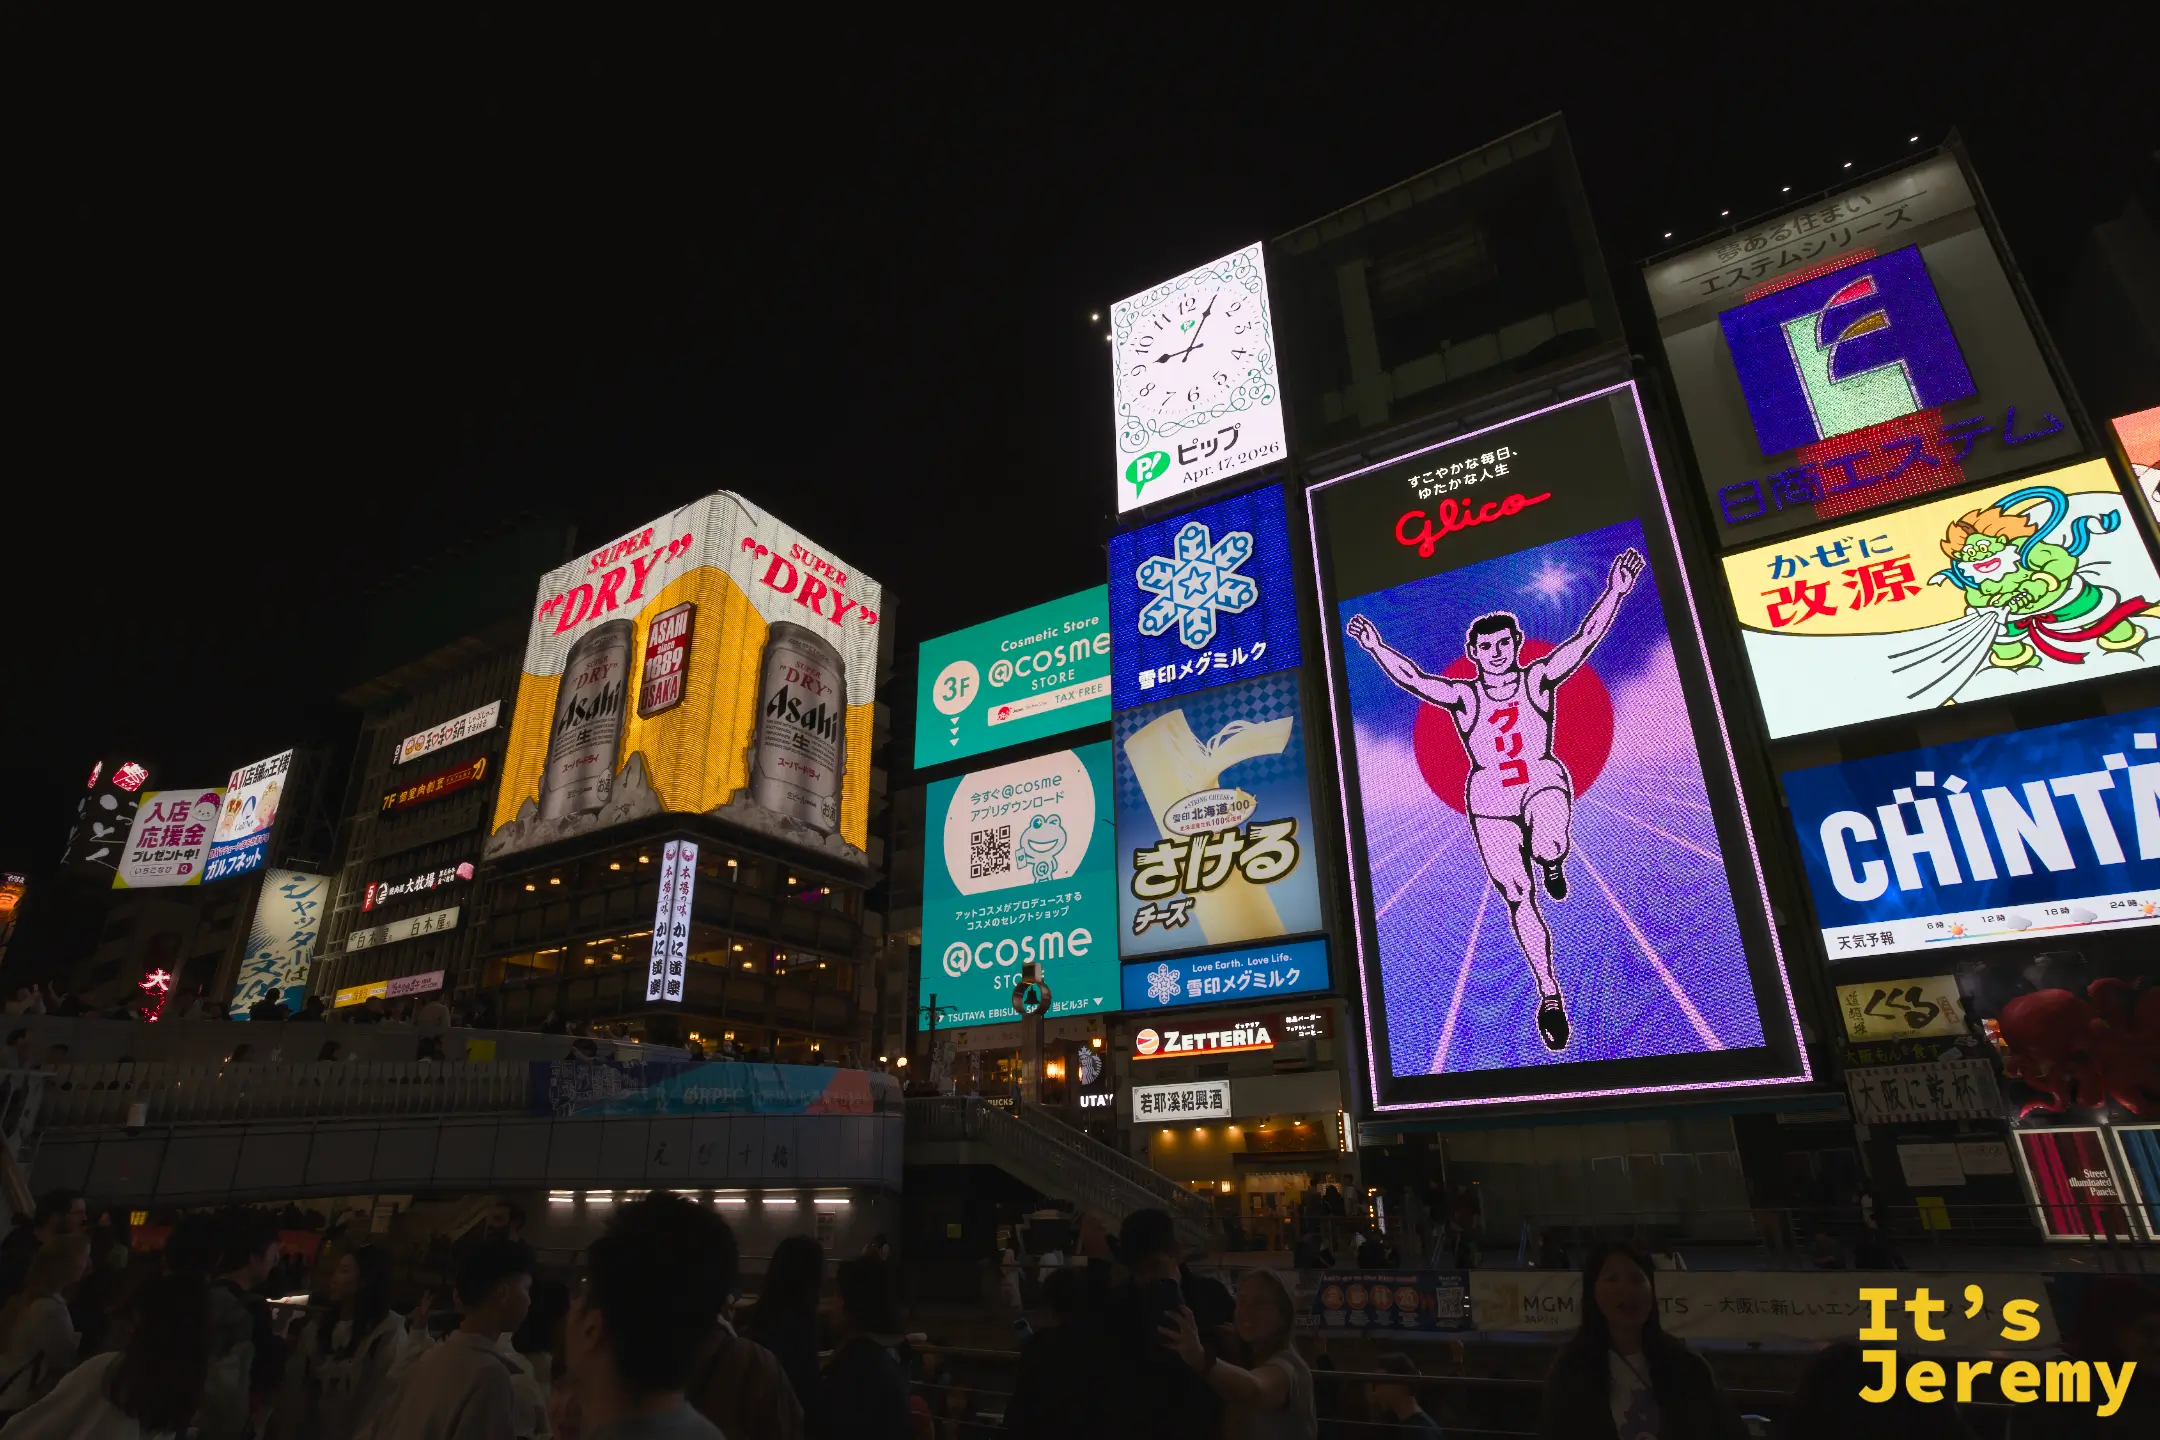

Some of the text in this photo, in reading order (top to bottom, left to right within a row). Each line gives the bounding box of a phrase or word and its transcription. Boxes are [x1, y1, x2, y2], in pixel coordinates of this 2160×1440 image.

[1714, 192, 1873, 265] 夢ある住まい
[1701, 203, 1912, 296] エステムシリーズ
[1178, 297, 1197, 315] 12
[1154, 314, 1171, 331] 11
[1234, 323, 1252, 335] 3
[1135, 335, 1154, 356] 10
[1230, 348, 1247, 361] 4
[1131, 364, 1147, 377] 9
[1212, 370, 1228, 386] 5
[1139, 382, 1156, 398] 8
[1161, 391, 1176, 407] 7
[1187, 386, 1200, 403] 6
[1178, 422, 1242, 466] ピップ
[1183, 441, 1280, 484] Apr. 17, 2026
[1407, 446, 1518, 489] すこやかな毎日、
[1717, 404, 2066, 523] 日商エステム
[1418, 463, 1510, 500] ゆたかな人生
[587, 527, 655, 575] SUPER
[1766, 533, 1895, 580] かぜに
[788, 543, 849, 588] SUPER
[1760, 553, 1923, 629] 改源
[648, 611, 688, 648] ASAHI
[1001, 614, 1099, 653] Cosmetic Store
[656, 641, 676, 655] since
[986, 631, 1110, 688] @cosme
[643, 646, 684, 682] 1889
[795, 660, 821, 677] SUPER
[1138, 640, 1267, 691] 雪印メグミルク
[941, 673, 971, 703] 3F
[1031, 668, 1076, 692] STORE
[640, 675, 681, 712] OSAKA
[1055, 683, 1103, 704] TAX FREE
[557, 680, 622, 736] Asahi
[766, 684, 838, 744] Asahi
[577, 729, 592, 746] 生
[792, 733, 811, 751] 生
[1487, 700, 1530, 788] グリコ
[229, 752, 292, 793] AI店舗の王様
[562, 753, 600, 775] スーパードライ
[777, 757, 821, 781] スーパードライ
[143, 799, 193, 825] 入店
[382, 793, 397, 811] 7F
[970, 790, 1065, 822] アプリダウンロード
[1173, 799, 1250, 823] 雪印 北海道 100
[1188, 793, 1230, 809] STRING CHEESE
[136, 822, 207, 849] 応援金
[132, 847, 201, 864] プレゼント中!
[205, 848, 262, 881] ガルフネット
[1131, 818, 1299, 900] さける
[366, 884, 375, 909] 5F
[404, 872, 436, 895] 大牧場
[660, 864, 673, 916] 本場の味
[676, 865, 692, 917] 本場の味
[955, 890, 1083, 920] アットコスメがプロデュースする
[1132, 898, 1196, 936] チーズ
[411, 914, 446, 937] 白木屋
[966, 906, 1070, 932] コスメのセレクトショップ
[1837, 930, 1896, 951] 天気予報
[1981, 913, 2006, 924] 12時
[2044, 906, 2071, 917] 18時
[357, 927, 390, 949] 白木屋
[649, 921, 667, 996] かに道楽
[667, 921, 687, 997] かに道楽
[942, 927, 1093, 978] @cosme
[1191, 952, 1293, 973] Love Earth. Love Life.
[993, 970, 1045, 990] STO
[1186, 966, 1301, 999] 雪印メグミルク
[947, 1011, 986, 1023] TSUTAYA
[1052, 998, 1089, 1012] 当ビル3F
[1164, 1027, 1272, 1053] ZETTERIA
[1299, 1028, 1323, 1037] コーヒー
[1857, 1072, 1977, 1114] 大阪に乾杯
[2069, 1177, 2113, 1188] Illuminated
[2083, 1168, 2108, 1179] Street
[2090, 1187, 2118, 1197] Panels.
[1523, 1296, 1574, 1313] MGM
